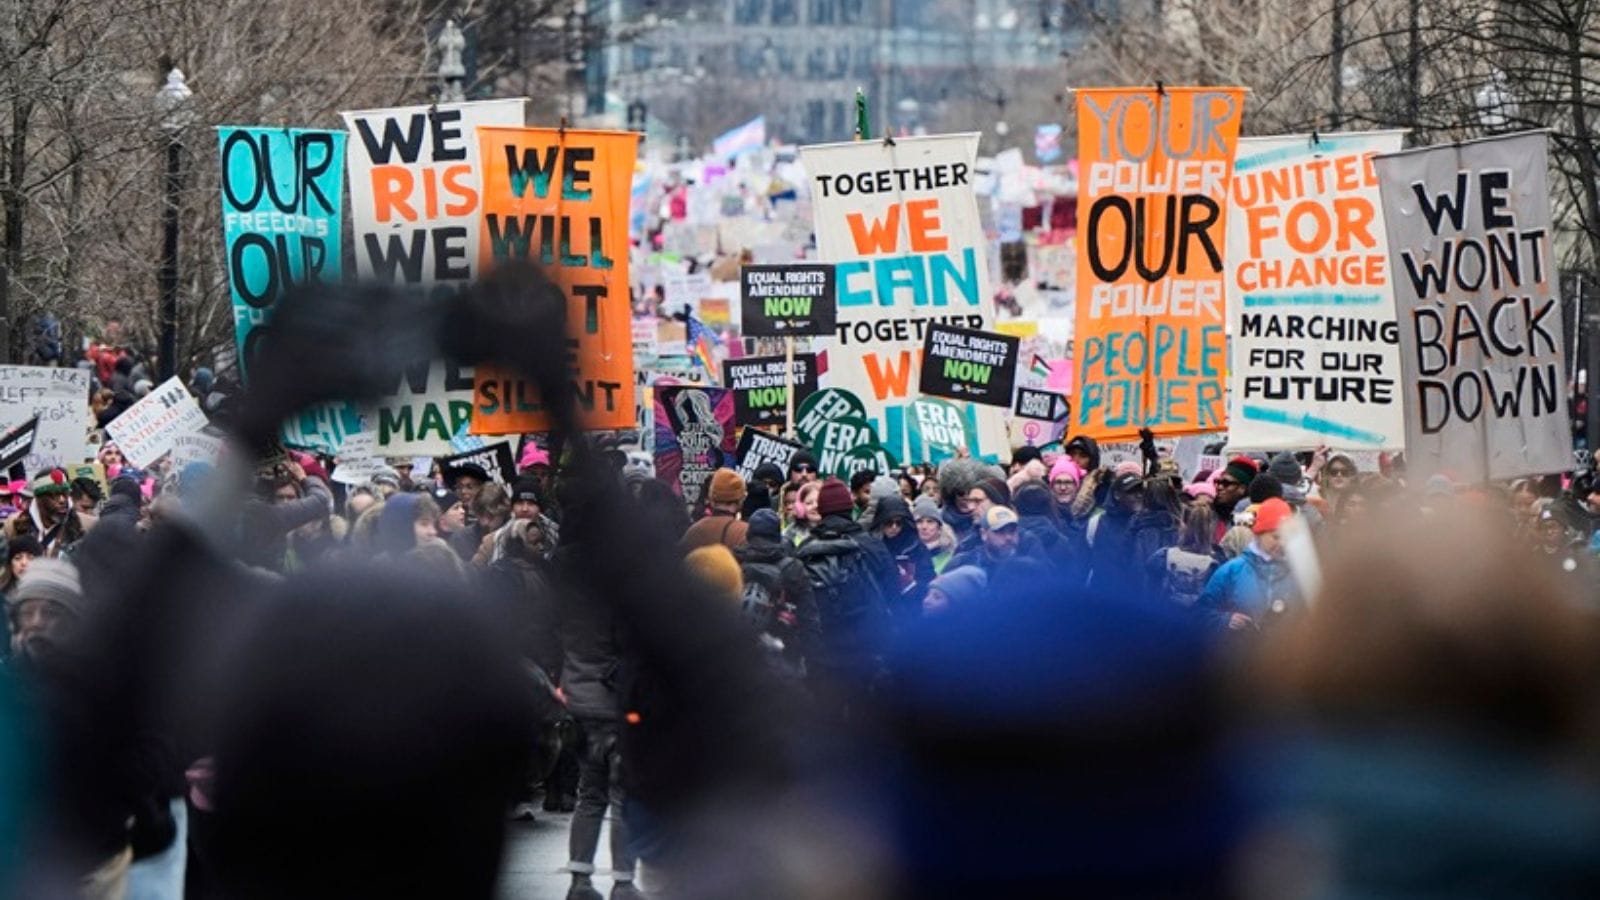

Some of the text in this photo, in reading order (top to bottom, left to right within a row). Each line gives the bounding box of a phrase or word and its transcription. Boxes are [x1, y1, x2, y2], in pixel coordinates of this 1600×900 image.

[355, 110, 467, 165] WE
[1084, 92, 1236, 163] YOUR
[222, 130, 335, 215] OUR
[504, 144, 595, 201] WE
[816, 162, 968, 197] TOGETHER
[1088, 159, 1227, 199] POWER
[370, 165, 479, 223] RIS
[1411, 170, 1515, 236] WE
[485, 212, 613, 269] WILL
[845, 198, 949, 256] WE
[1087, 194, 1224, 283] OUR
[1246, 197, 1377, 259] FOR
[364, 226, 470, 283] WE
[1236, 255, 1386, 292] CHANGE
[1401, 229, 1546, 299] WONT
[748, 271, 826, 286] EQUAL RIGHTS
[749, 284, 825, 297] AMENDMENT
[836, 247, 980, 307] CAN
[764, 296, 813, 317] NOW
[1089, 276, 1222, 321] POWER
[931, 330, 1008, 354] EQUAL RIGHTS
[1240, 313, 1399, 344] MARCHING
[1413, 296, 1558, 377] BACK
[731, 360, 807, 378] EQUAL RIGTS
[862, 348, 925, 401] W
[930, 343, 1008, 367] AMENDMENT
[943, 358, 992, 385] NOW
[1080, 324, 1223, 385] PEOPLE
[1250, 348, 1383, 376] FOR OUR
[479, 379, 621, 415] SILNT
[733, 373, 806, 390] AMENDMNT
[1244, 376, 1395, 404] FUTURE
[1417, 363, 1558, 434] DOWN
[915, 400, 964, 429] ERA
[1080, 379, 1223, 428] POWER
[751, 433, 799, 462] TRUST
[824, 421, 870, 451] ERA
[921, 422, 966, 451] NOW
